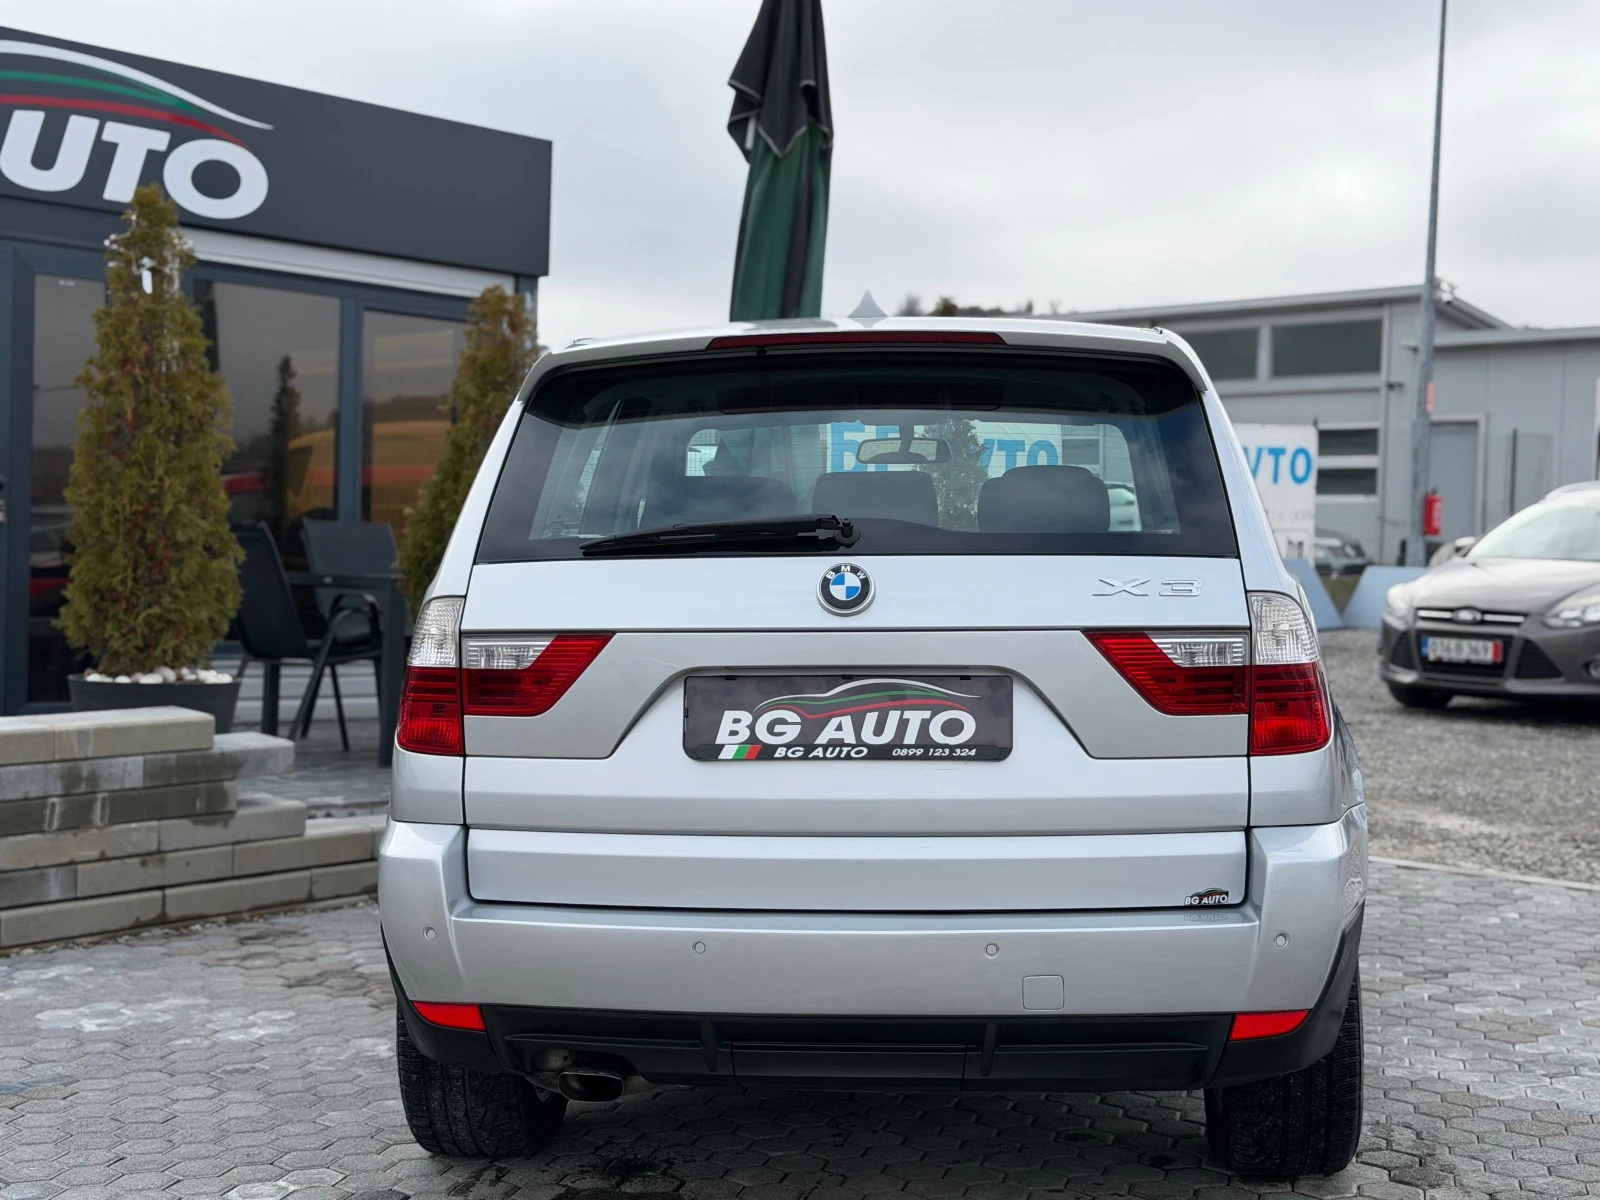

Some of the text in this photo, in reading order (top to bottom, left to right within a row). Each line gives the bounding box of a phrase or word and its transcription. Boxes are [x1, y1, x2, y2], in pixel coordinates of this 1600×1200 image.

[826, 565, 867, 580] BMW
[1092, 578, 1203, 597] X3
[715, 709, 976, 745] BG AUTO
[774, 746, 976, 758] BG AUTO 0899 123 324
[1185, 894, 1228, 905] BG AUTO
